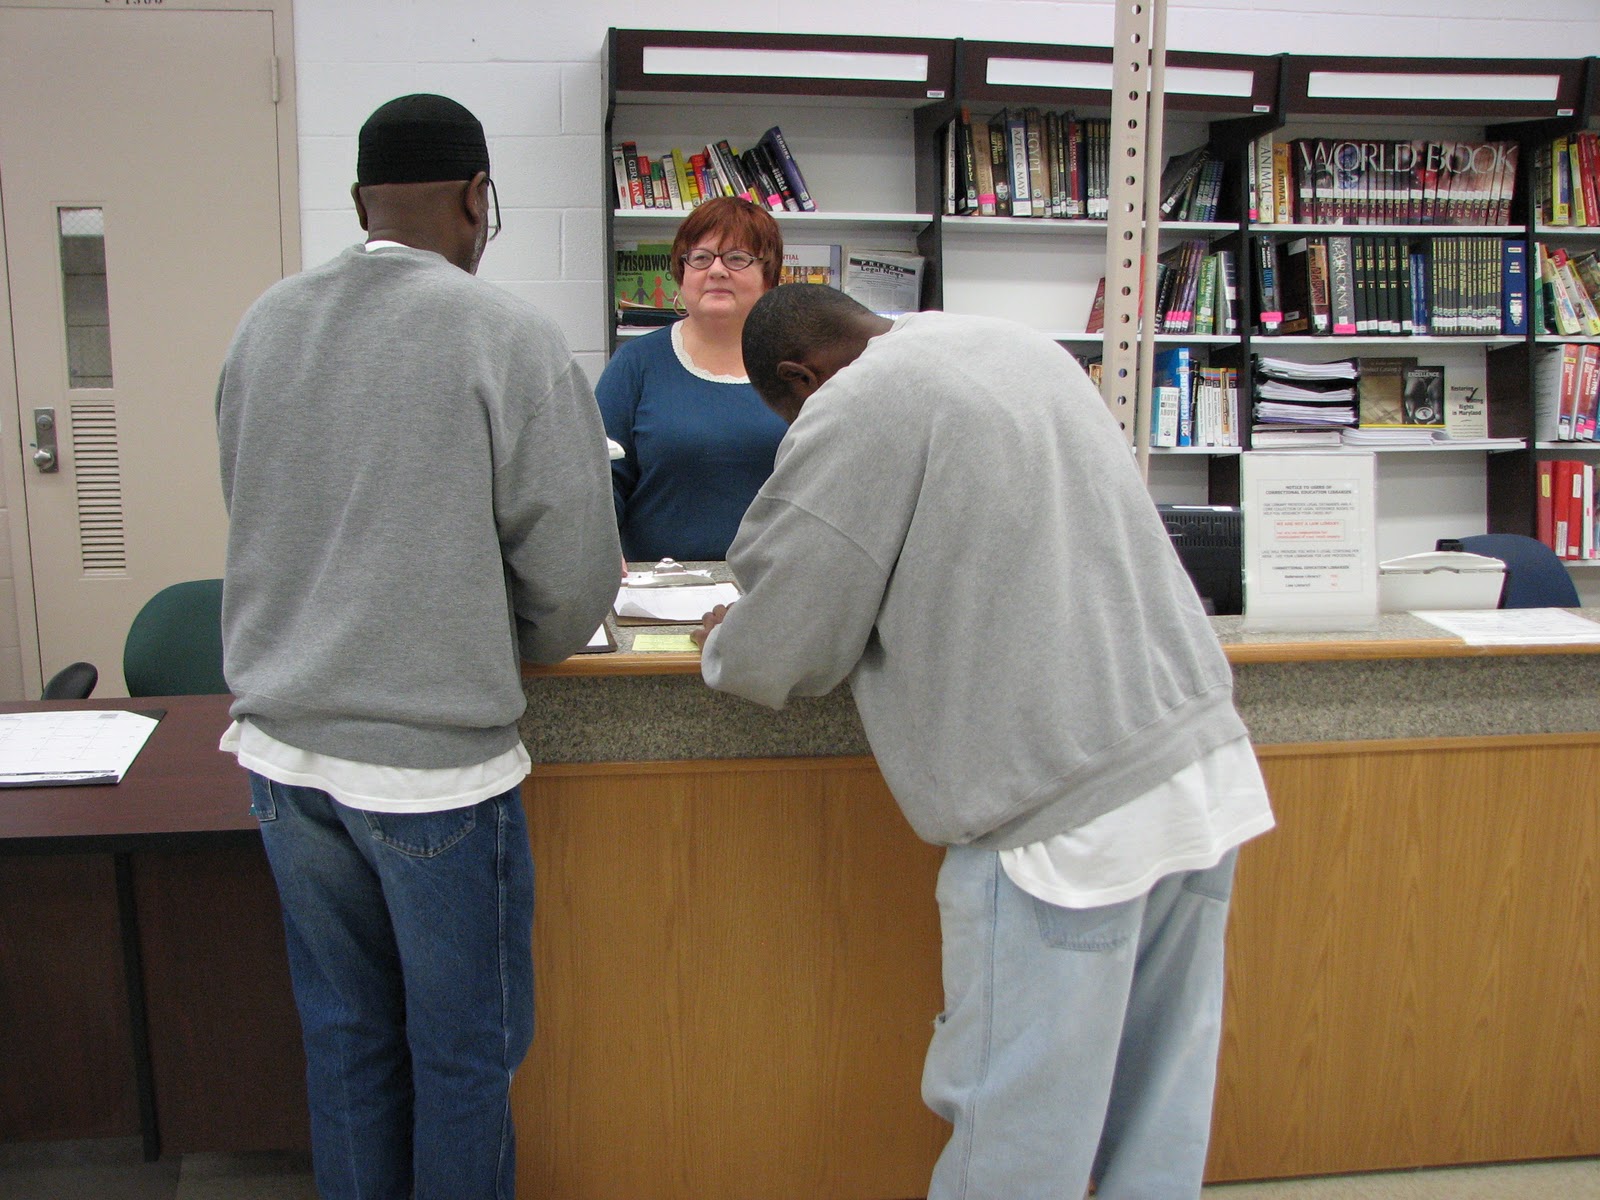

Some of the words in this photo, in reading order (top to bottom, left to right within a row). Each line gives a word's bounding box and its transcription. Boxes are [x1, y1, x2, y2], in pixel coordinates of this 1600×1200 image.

[1013, 129, 1024, 159] AZTEC
[1027, 131, 1041, 174] EGYPT
[1300, 141, 1418, 173] WORLD
[1425, 143, 1518, 174] BOOK
[628, 159, 641, 198] GERMAN
[1016, 171, 1025, 197] MAYA
[1260, 147, 1273, 196] ANIMAL
[1277, 168, 1286, 207] ANIMAL
[860, 266, 881, 274] Legal
[861, 260, 904, 272] PRISON
[1180, 374, 1188, 420] ICEBREAKERS
